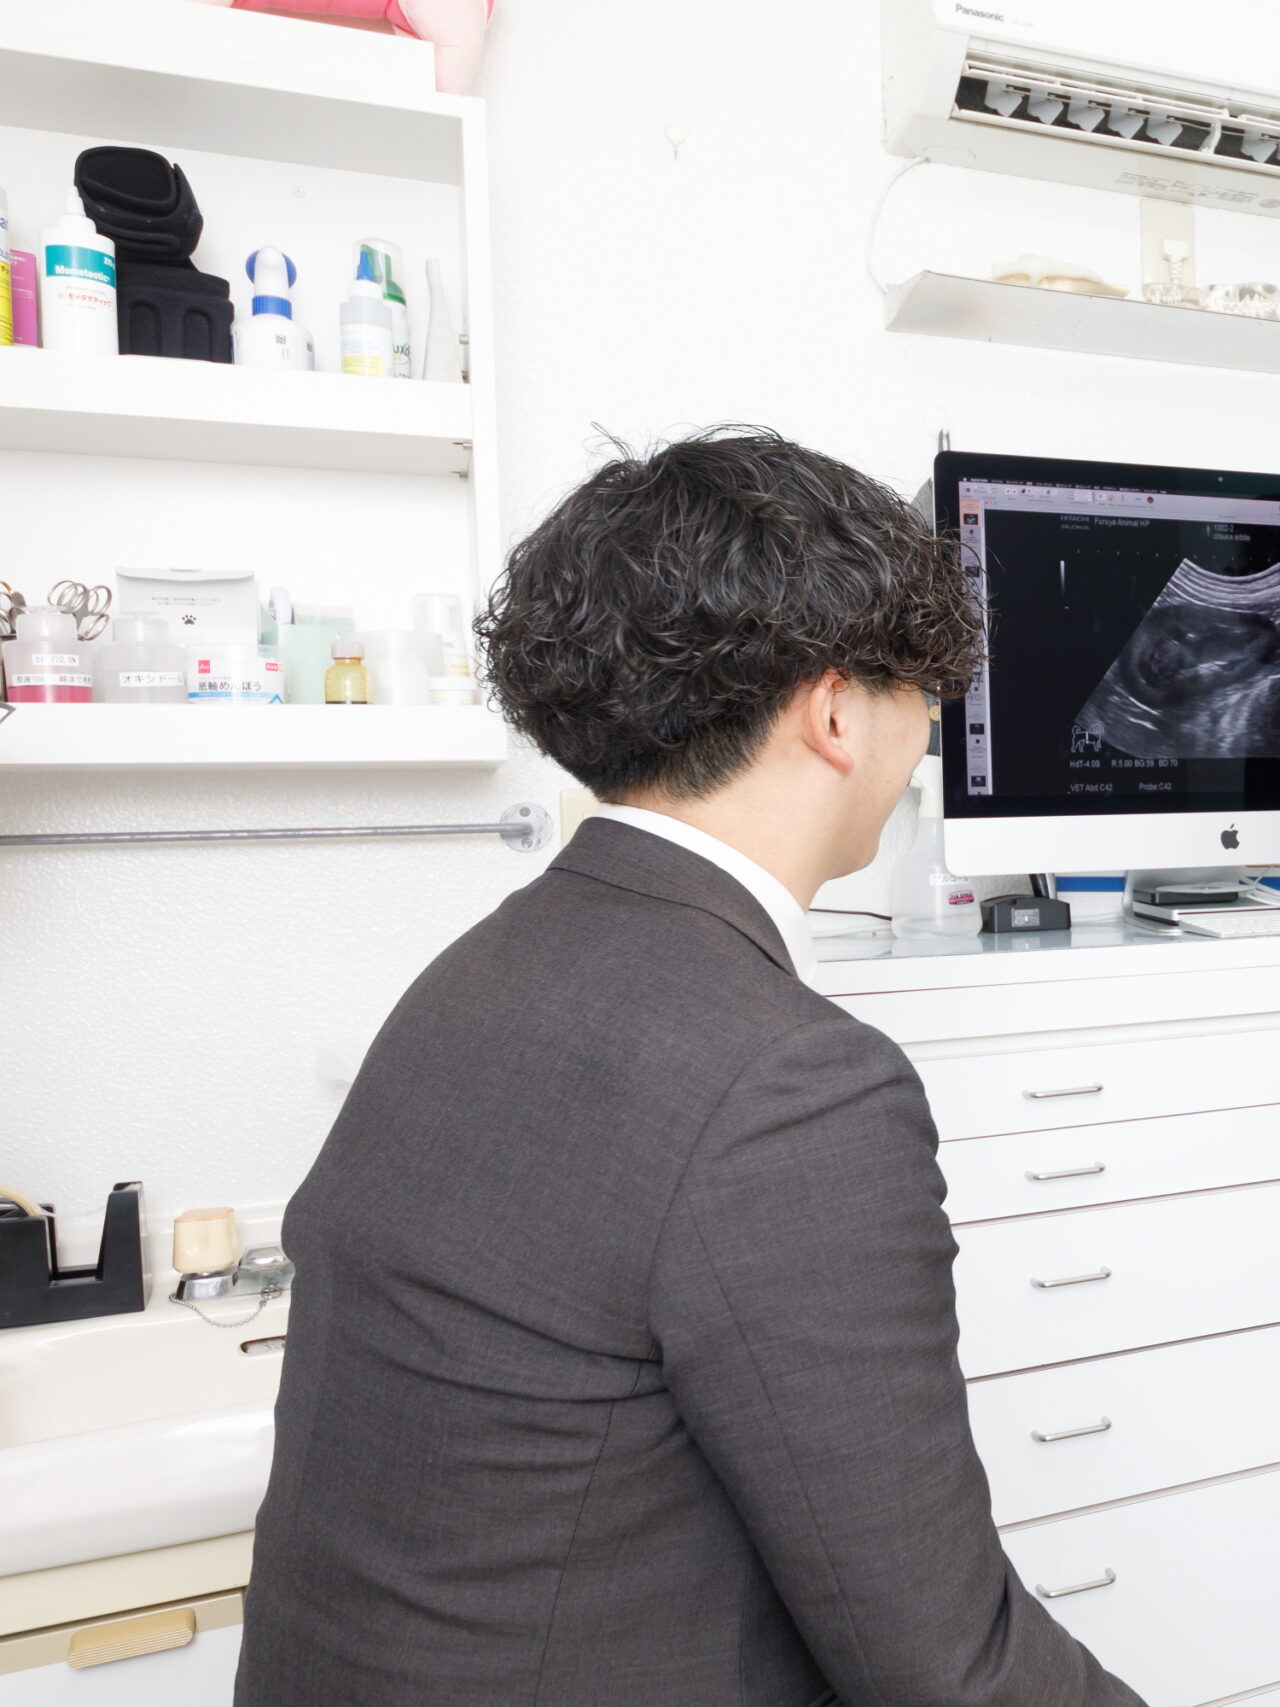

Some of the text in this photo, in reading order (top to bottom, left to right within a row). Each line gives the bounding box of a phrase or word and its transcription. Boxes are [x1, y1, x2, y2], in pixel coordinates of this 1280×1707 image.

[955, 2, 1005, 23] Panasonic
[1117, 518, 1139, 527] Animal
[1140, 519, 1151, 527] HP
[122, 675, 184, 686] オキシドール
